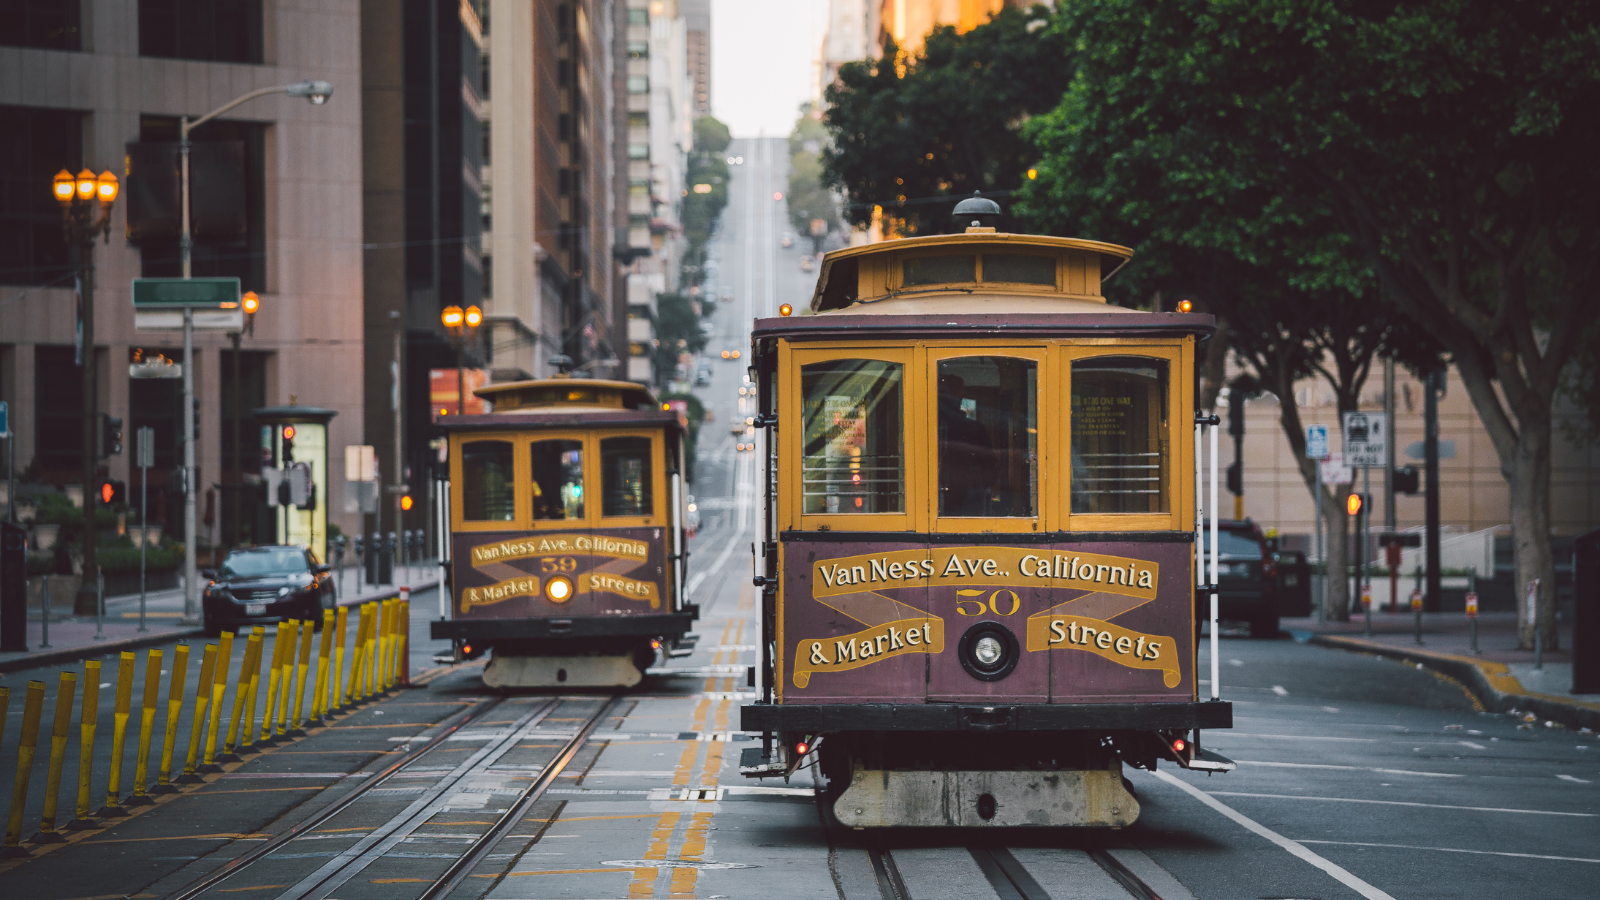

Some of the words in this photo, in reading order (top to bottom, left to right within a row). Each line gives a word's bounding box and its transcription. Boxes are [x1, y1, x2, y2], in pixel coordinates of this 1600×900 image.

[1100, 397, 1114, 405] ONE
[1116, 397, 1131, 405] WAY
[473, 545, 500, 561] Van
[500, 540, 535, 556] Ness
[575, 537, 646, 557] California
[540, 556, 578, 574] 59
[818, 564, 866, 589] Van
[869, 554, 935, 582] Ness
[1019, 554, 1154, 590] California
[469, 589, 480, 602] &
[482, 579, 534, 601] Market
[589, 575, 651, 597] Streets
[955, 588, 1021, 617] 50
[809, 643, 830, 665] &
[833, 622, 933, 665] Market
[1048, 619, 1163, 662] Streets
